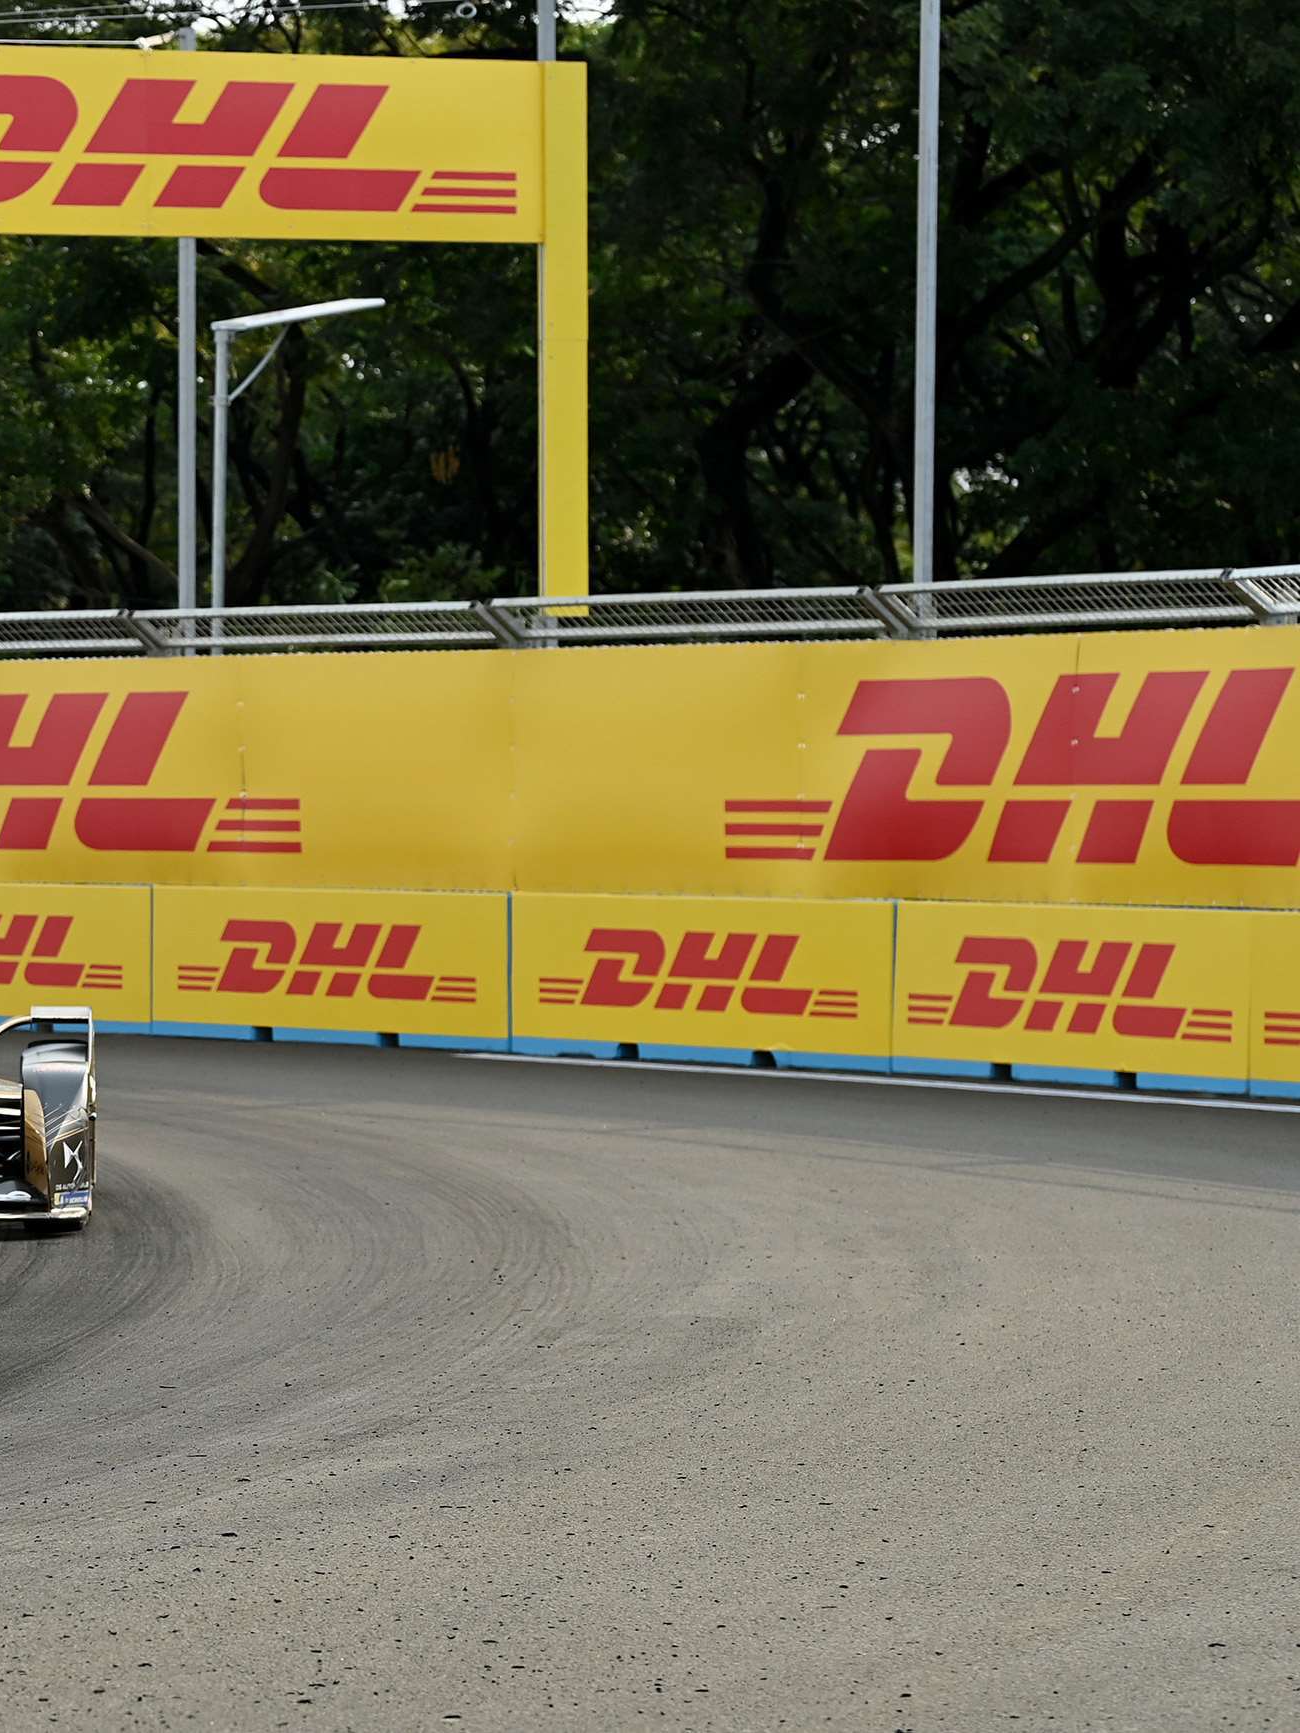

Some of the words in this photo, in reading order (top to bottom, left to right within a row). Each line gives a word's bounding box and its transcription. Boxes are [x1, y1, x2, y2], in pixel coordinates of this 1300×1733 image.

[824, 667, 1300, 866] DHL
[217, 919, 435, 1001] DHL
[581, 928, 813, 1015] DHL
[948, 936, 1188, 1039] DHL
